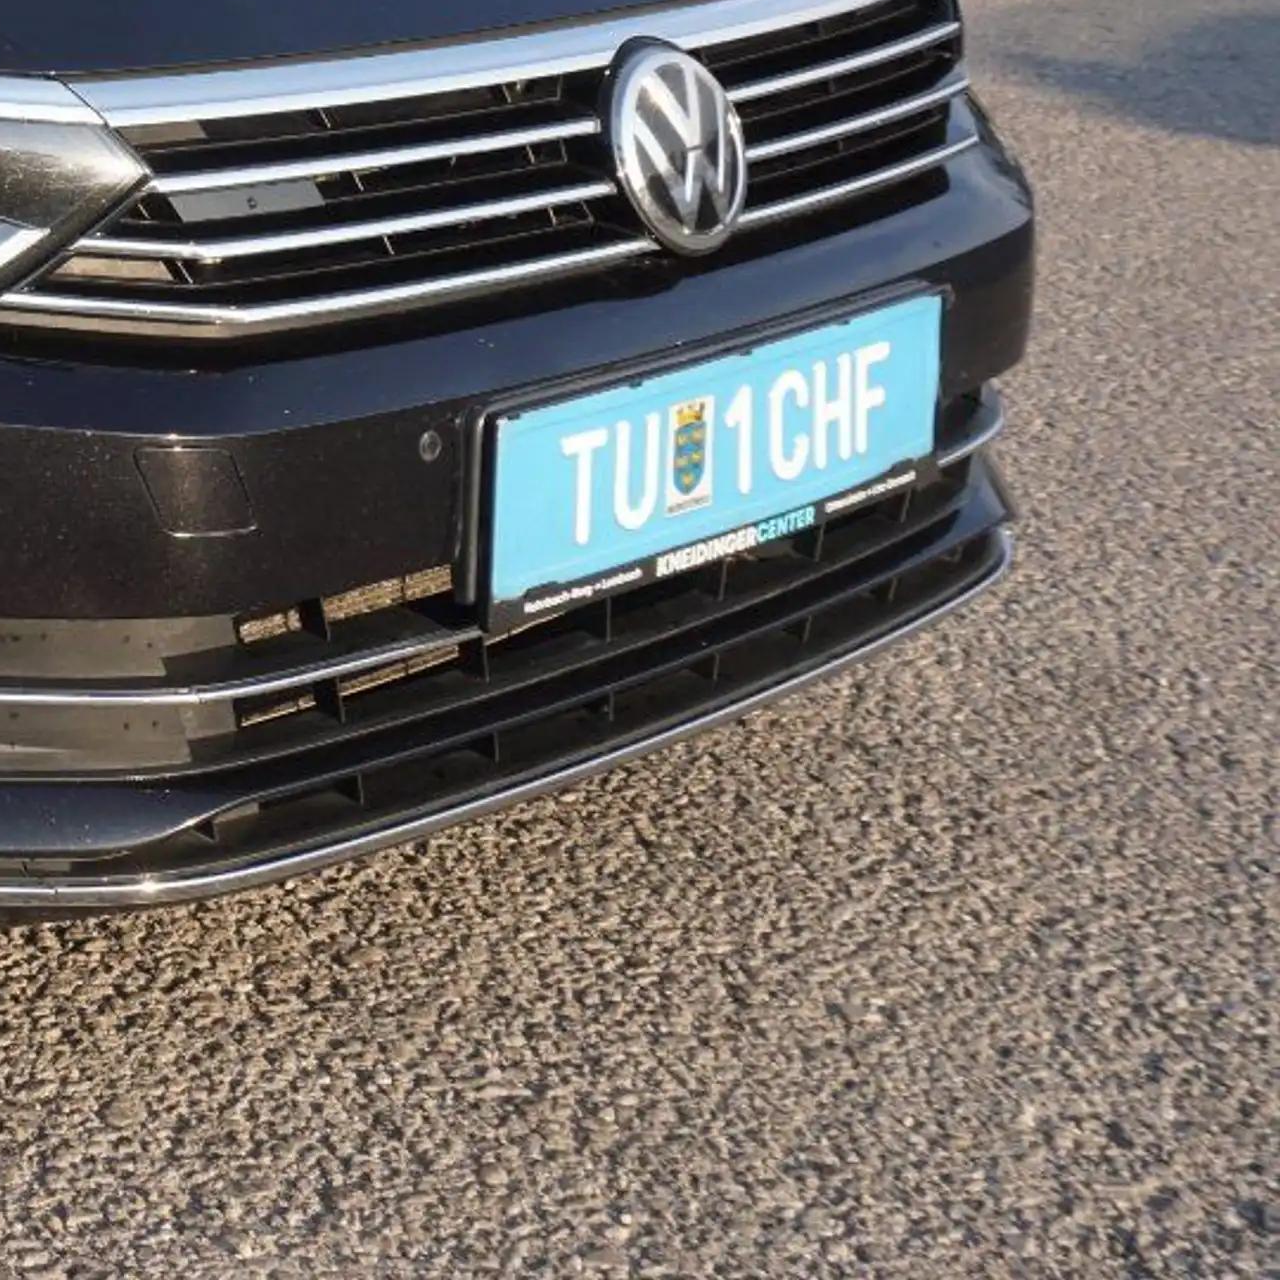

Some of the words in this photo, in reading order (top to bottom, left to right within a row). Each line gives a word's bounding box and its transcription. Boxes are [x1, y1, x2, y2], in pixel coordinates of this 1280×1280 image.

[559, 411, 661, 546] TU
[724, 340, 891, 496] 1CHF
[655, 506, 816, 578] KNEIDINGERCENTER
